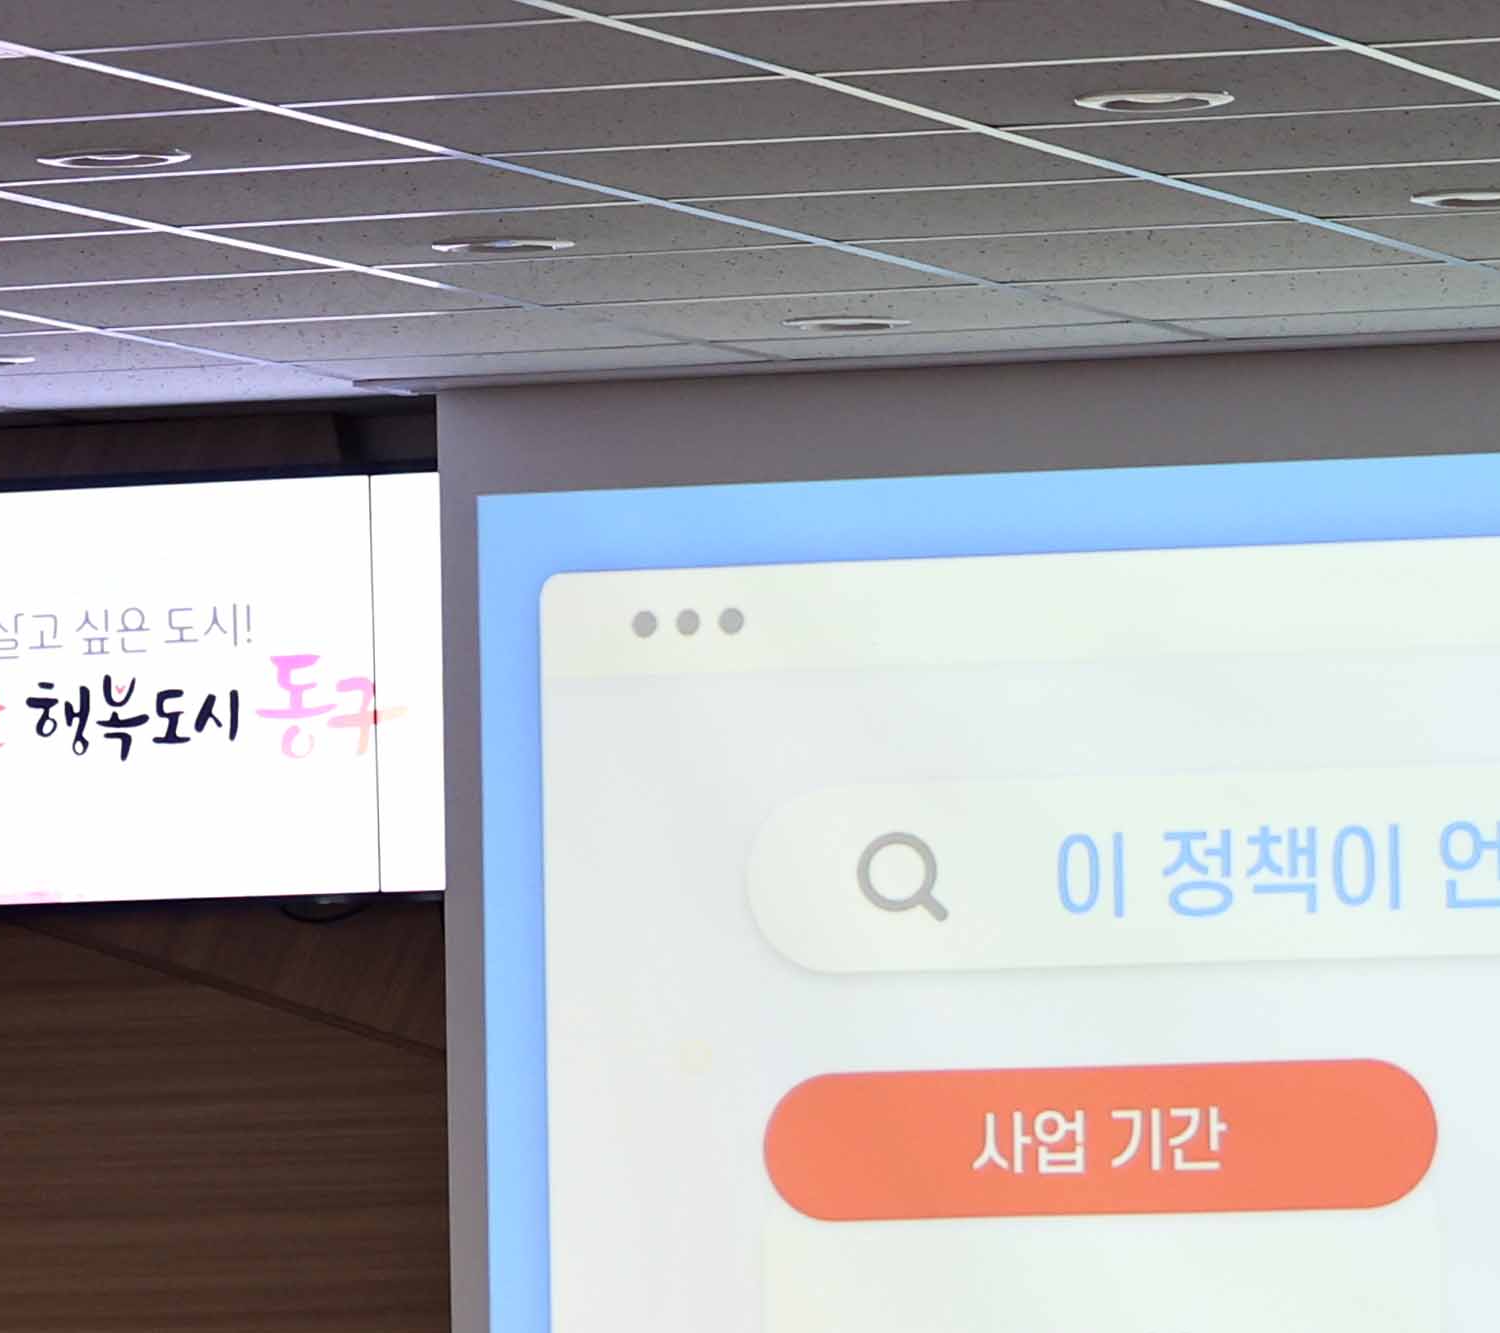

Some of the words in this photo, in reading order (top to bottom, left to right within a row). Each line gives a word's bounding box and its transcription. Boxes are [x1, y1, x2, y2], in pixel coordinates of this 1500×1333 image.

[75, 607, 151, 656] 싶은
[164, 602, 253, 647] 도시!
[25, 674, 240, 762] 행복도시
[256, 653, 408, 760] 동구
[1057, 831, 1125, 919] 이
[1161, 823, 1401, 918] 정책이
[972, 1110, 1086, 1176] 사업
[1111, 1106, 1229, 1172] 기간
